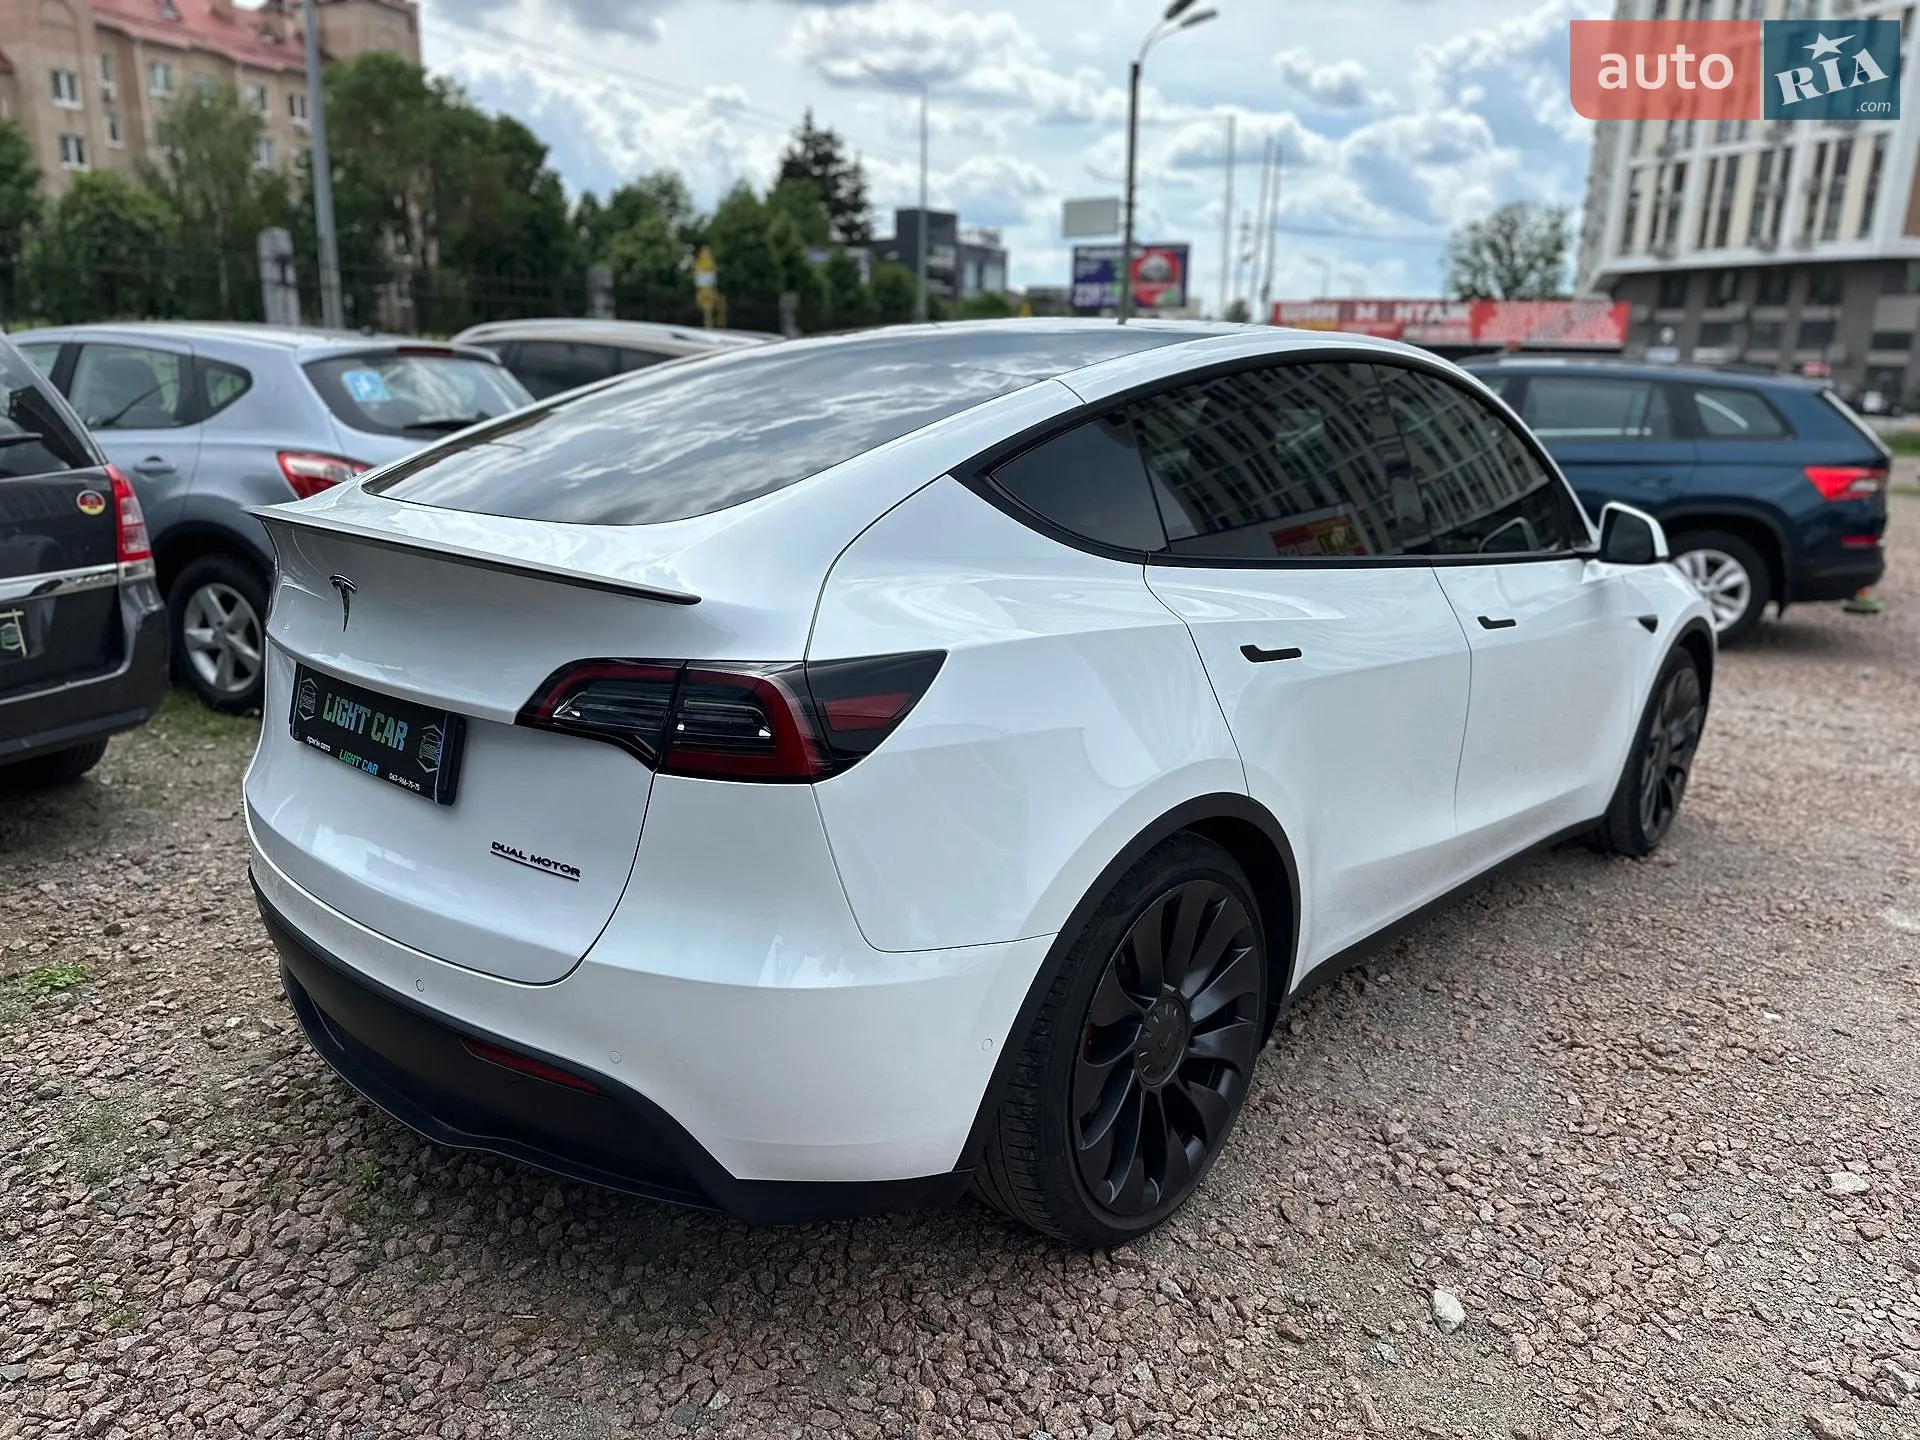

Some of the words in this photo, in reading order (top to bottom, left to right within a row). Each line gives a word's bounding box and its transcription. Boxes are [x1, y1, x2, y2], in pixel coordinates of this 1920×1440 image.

[322, 692, 371, 735] LIGHT
[370, 712, 409, 751] CAR
[338, 749, 362, 767] LIGHT
[361, 758, 379, 776] CAR
[491, 841, 527, 860] DUAL
[529, 854, 581, 877] MOTOR
